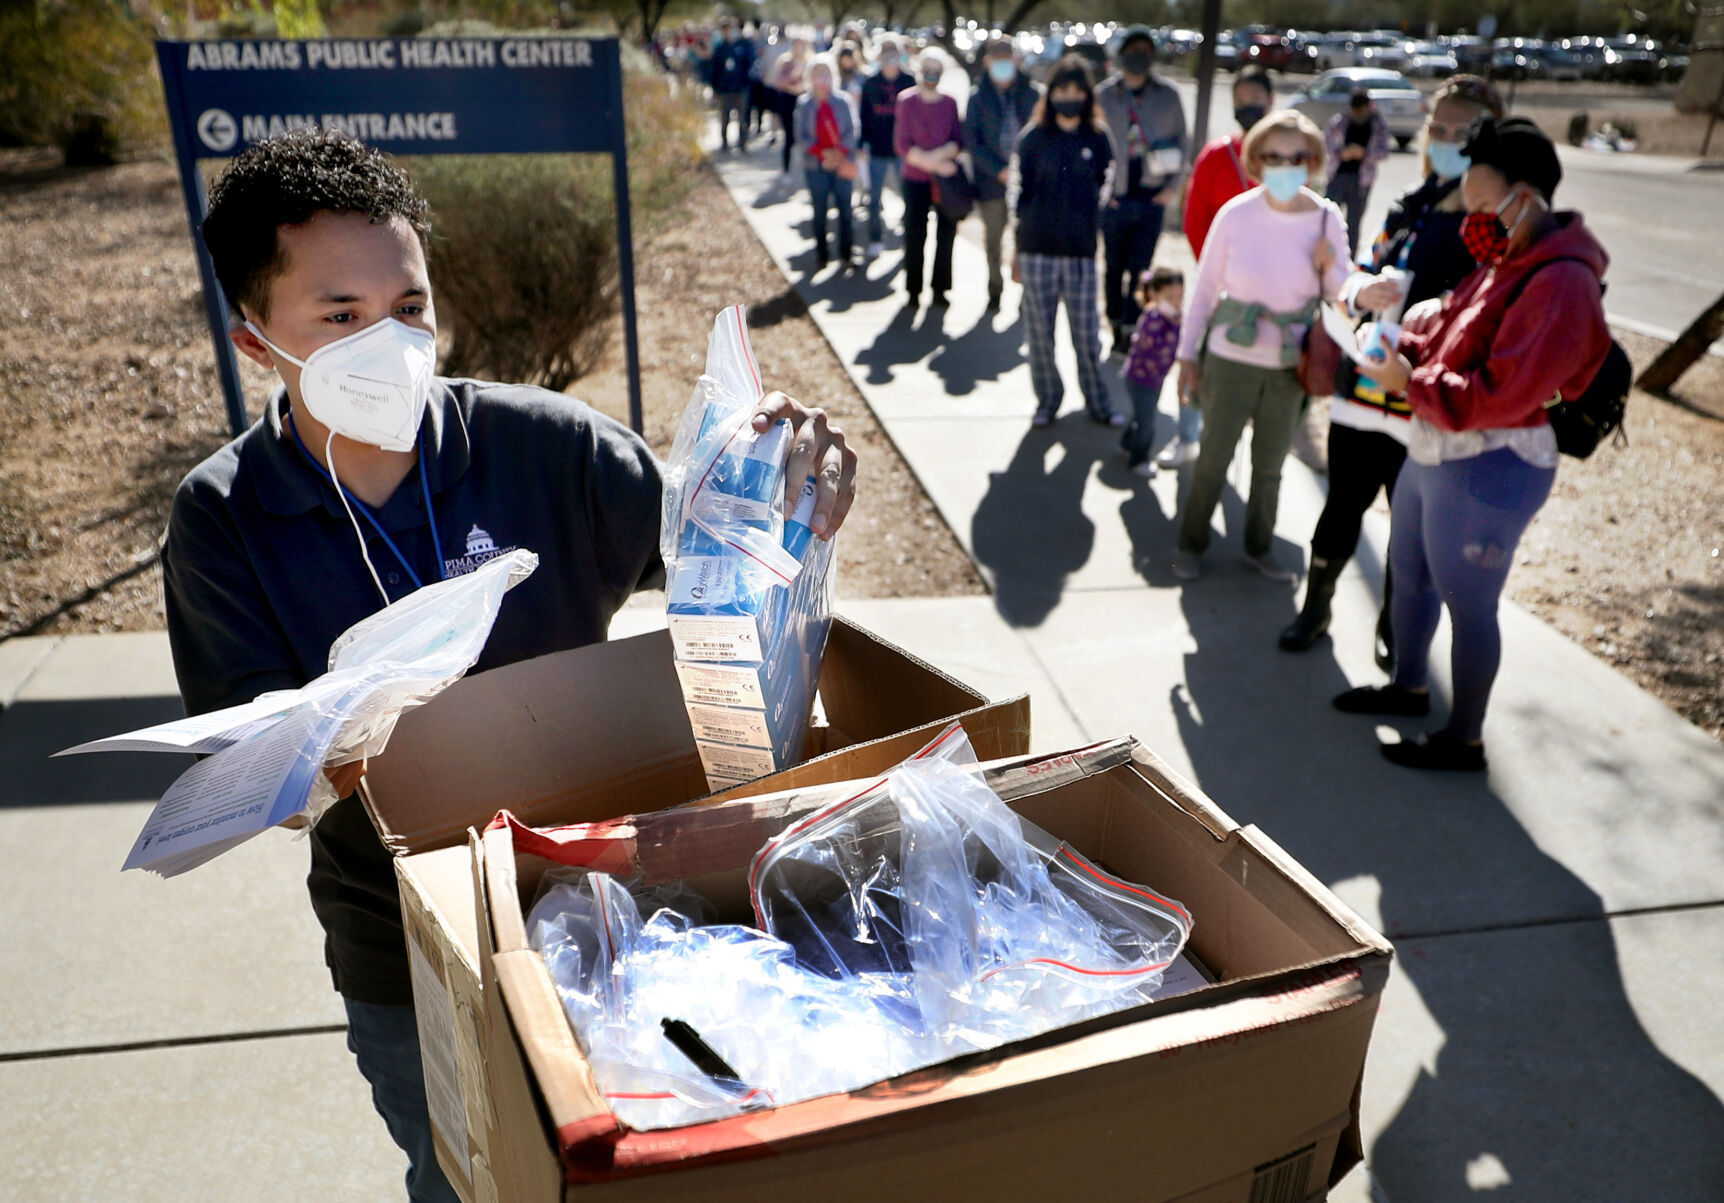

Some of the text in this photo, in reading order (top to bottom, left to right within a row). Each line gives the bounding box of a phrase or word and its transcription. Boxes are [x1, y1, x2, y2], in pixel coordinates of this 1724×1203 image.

[187, 39, 592, 70] ABRAMS PUBLIC HEALTH CENTER
[321, 112, 456, 140] ENTRANCE
[339, 384, 389, 403] Honeywell
[445, 555, 475, 570] PIMA
